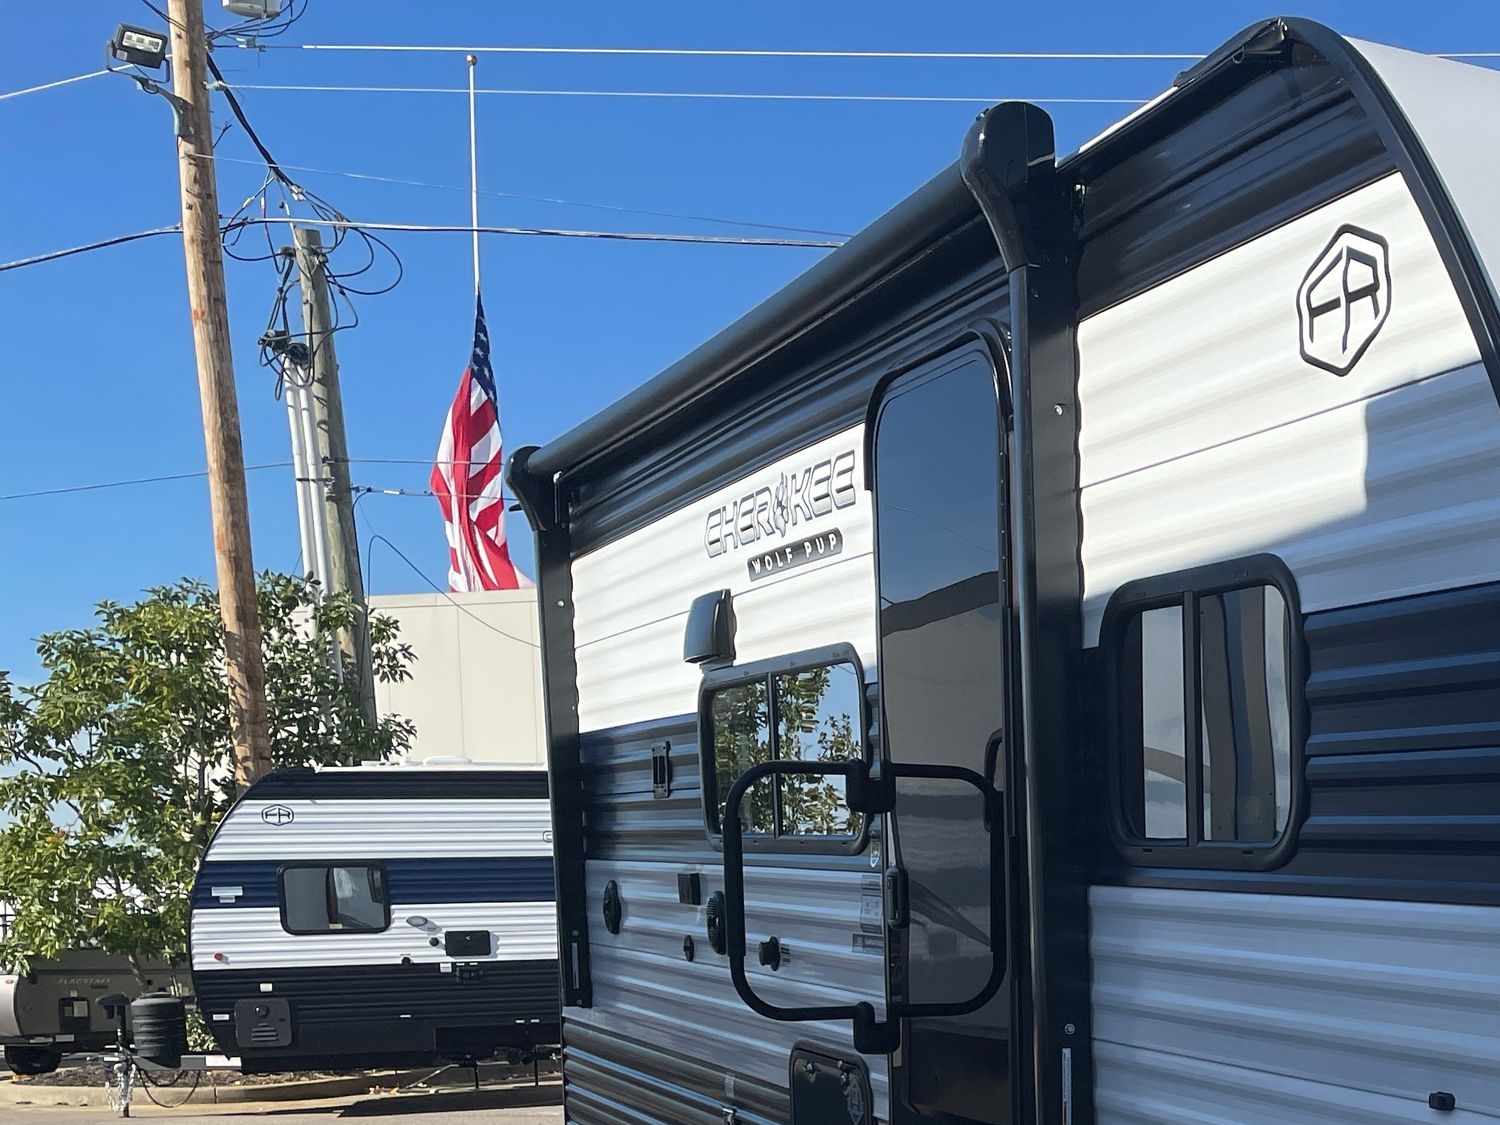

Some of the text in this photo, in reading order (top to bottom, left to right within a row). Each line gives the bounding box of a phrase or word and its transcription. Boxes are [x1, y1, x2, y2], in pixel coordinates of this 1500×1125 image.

[703, 448, 857, 559] CHEROKEE
[751, 533, 837, 575] WOLF PUP
